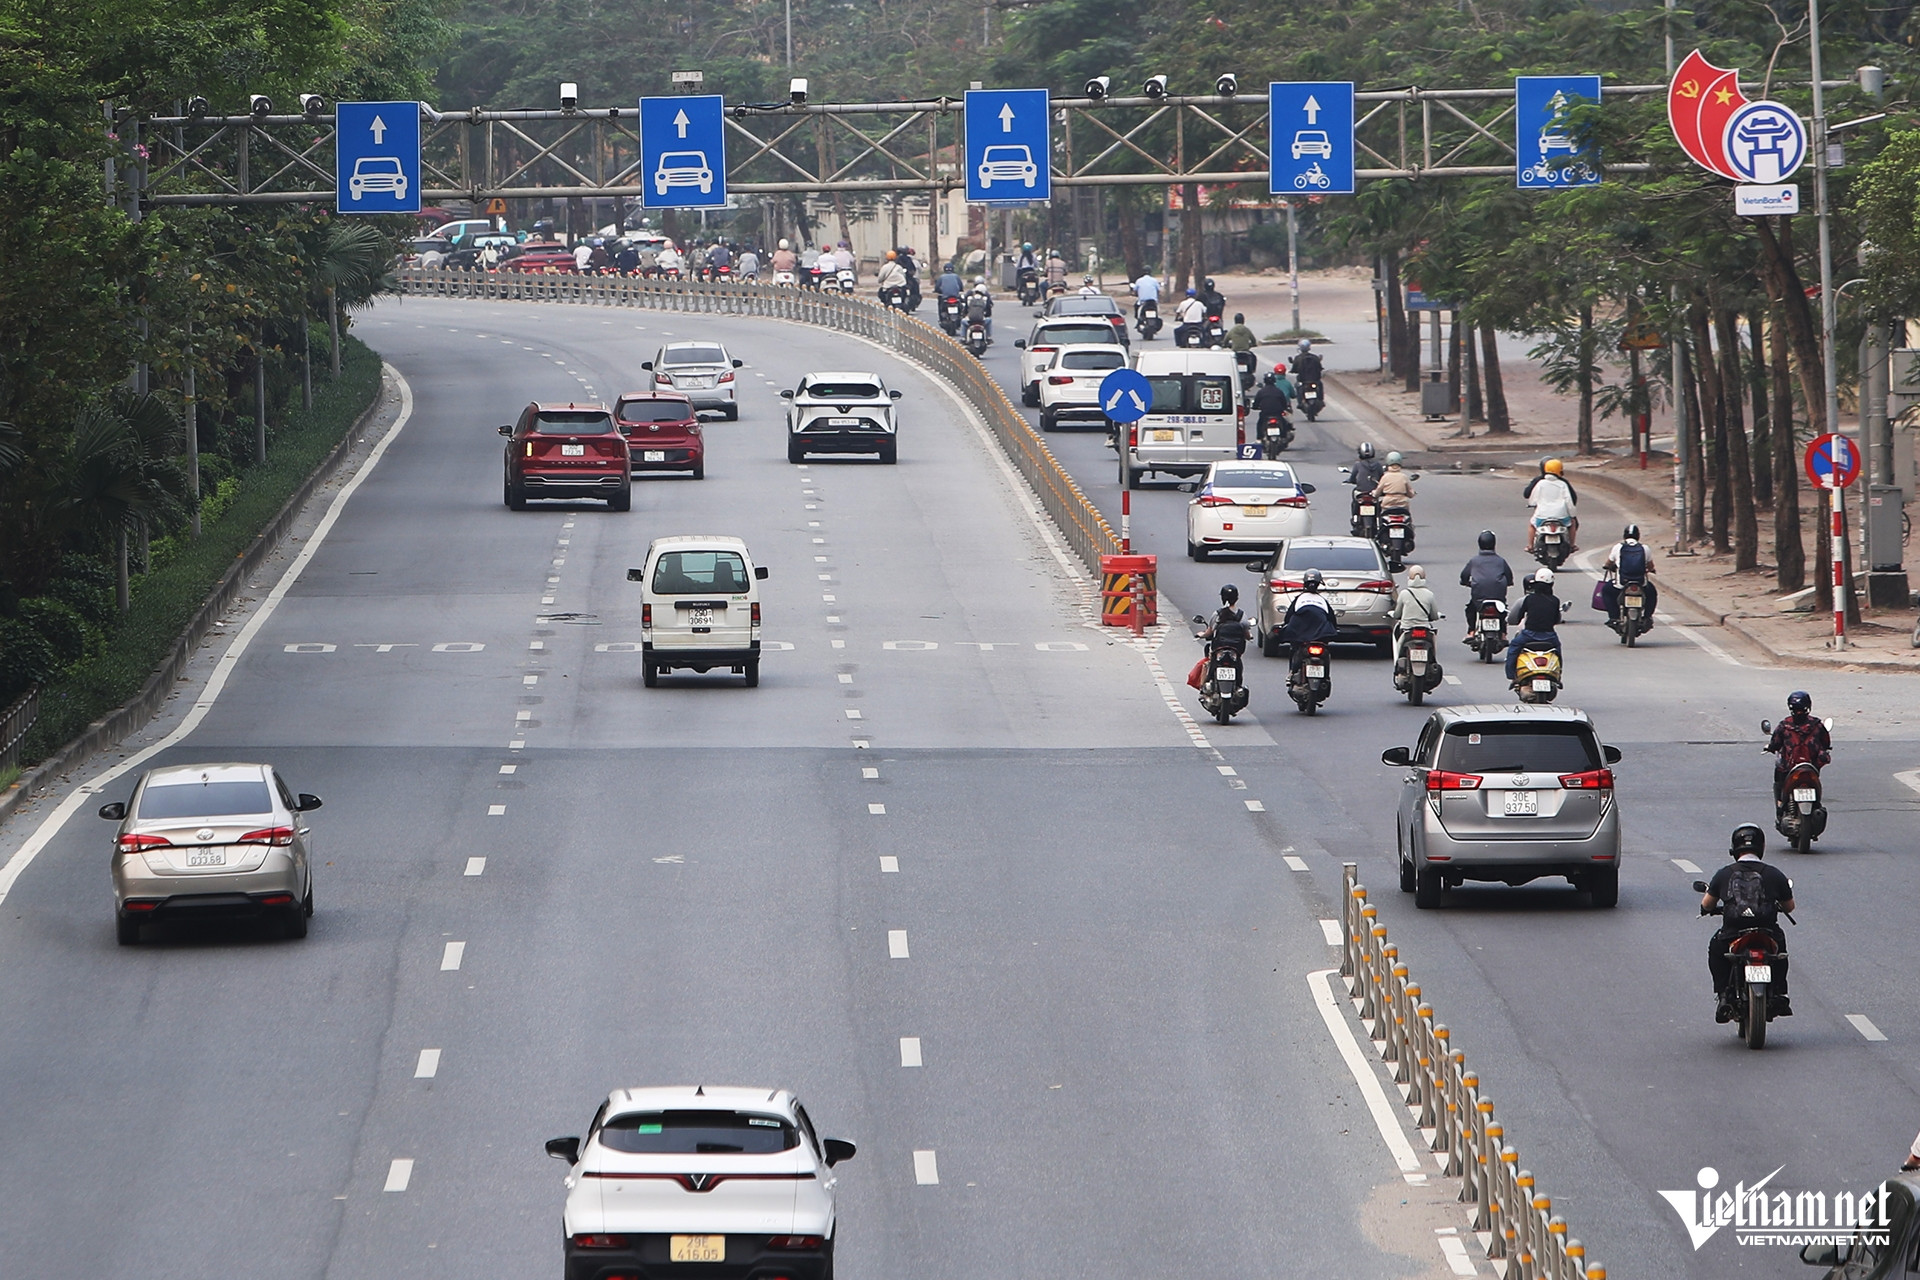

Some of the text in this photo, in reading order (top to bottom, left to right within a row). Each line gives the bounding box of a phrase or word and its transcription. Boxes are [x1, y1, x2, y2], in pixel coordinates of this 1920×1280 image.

[1742, 196, 1782, 204] VietinBank
[1241, 445, 1257, 459] G7
[1512, 792, 1529, 802] 30E
[1505, 802, 1537, 813] 937.50
[190, 856, 222, 865] 033.68
[686, 1235, 709, 1249] 29E
[677, 1249, 718, 1261] 416.05
